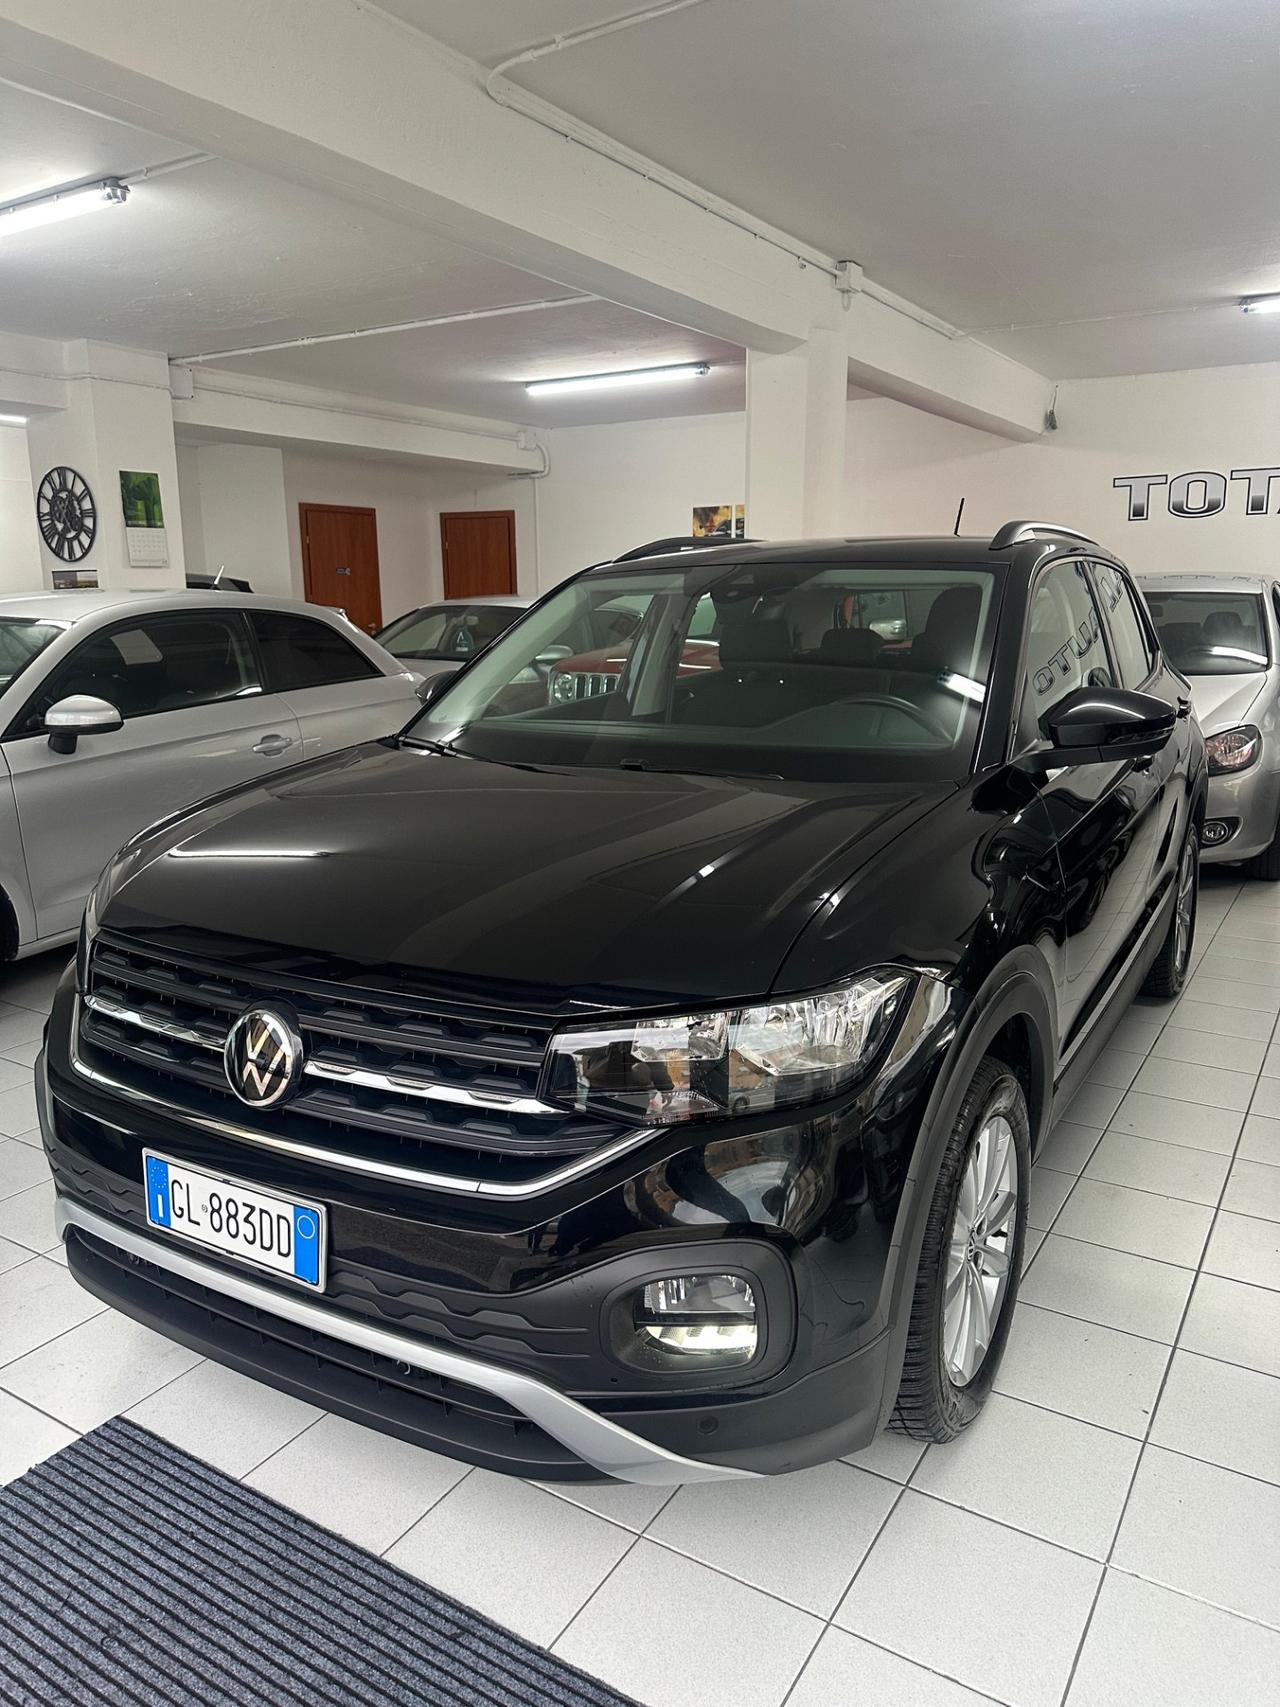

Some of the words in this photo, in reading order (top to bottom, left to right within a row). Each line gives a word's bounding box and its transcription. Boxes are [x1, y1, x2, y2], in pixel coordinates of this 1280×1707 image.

[1113, 467, 1280, 521] TOT
[171, 1178, 201, 1226] GL
[209, 1192, 292, 1258] 883DD
